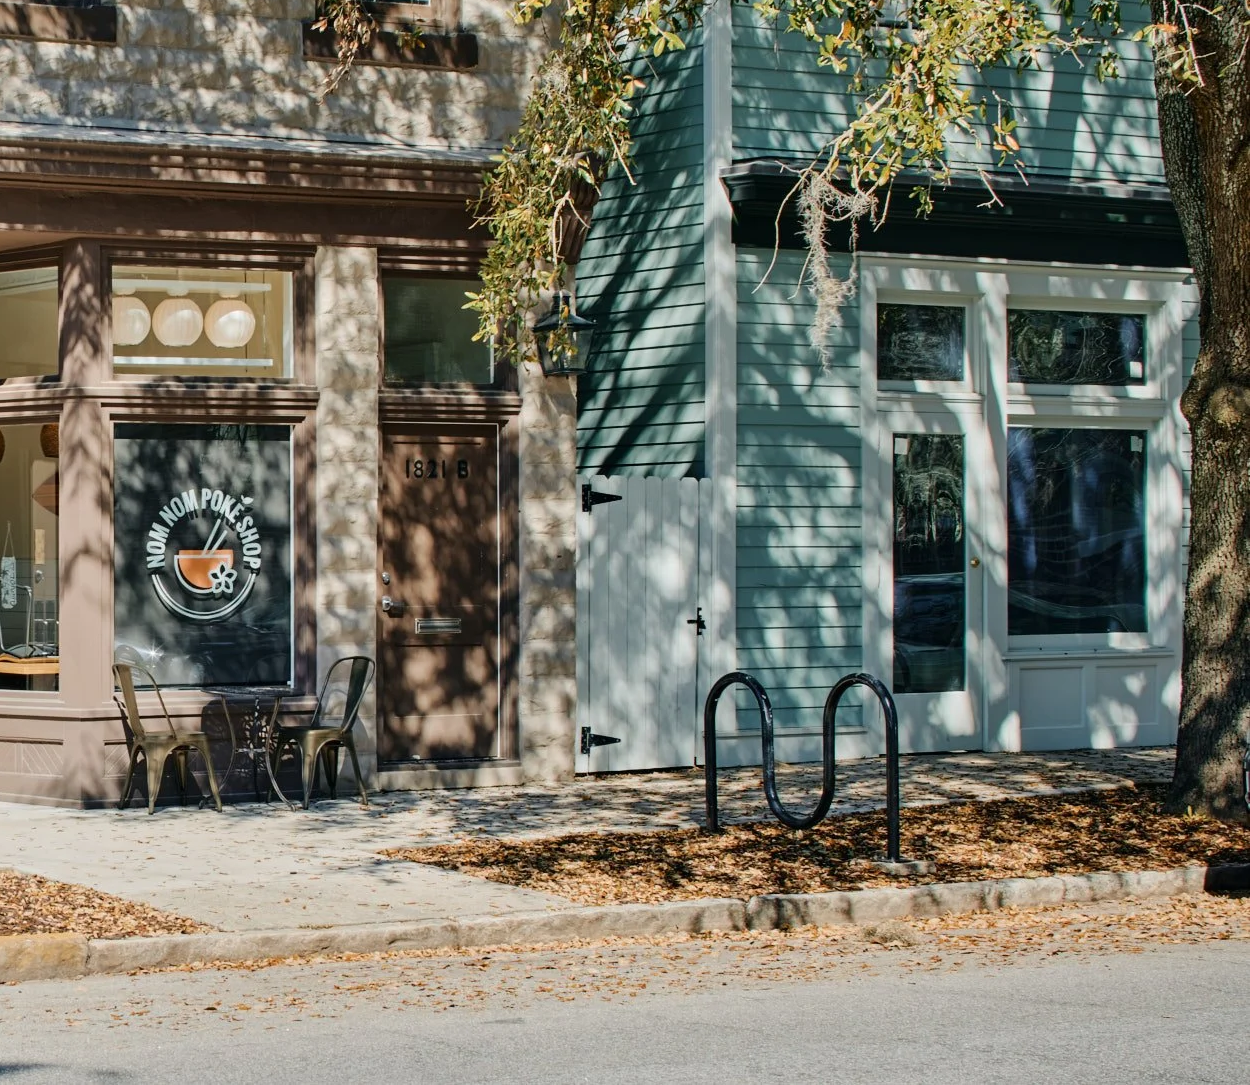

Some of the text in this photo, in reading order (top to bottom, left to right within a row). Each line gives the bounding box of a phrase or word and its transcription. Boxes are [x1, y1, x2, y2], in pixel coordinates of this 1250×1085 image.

[405, 459, 468, 479] 1821 B
[146, 521, 170, 570] NOM
[159, 489, 199, 528] NOM
[235, 517, 262, 570] SHOP
